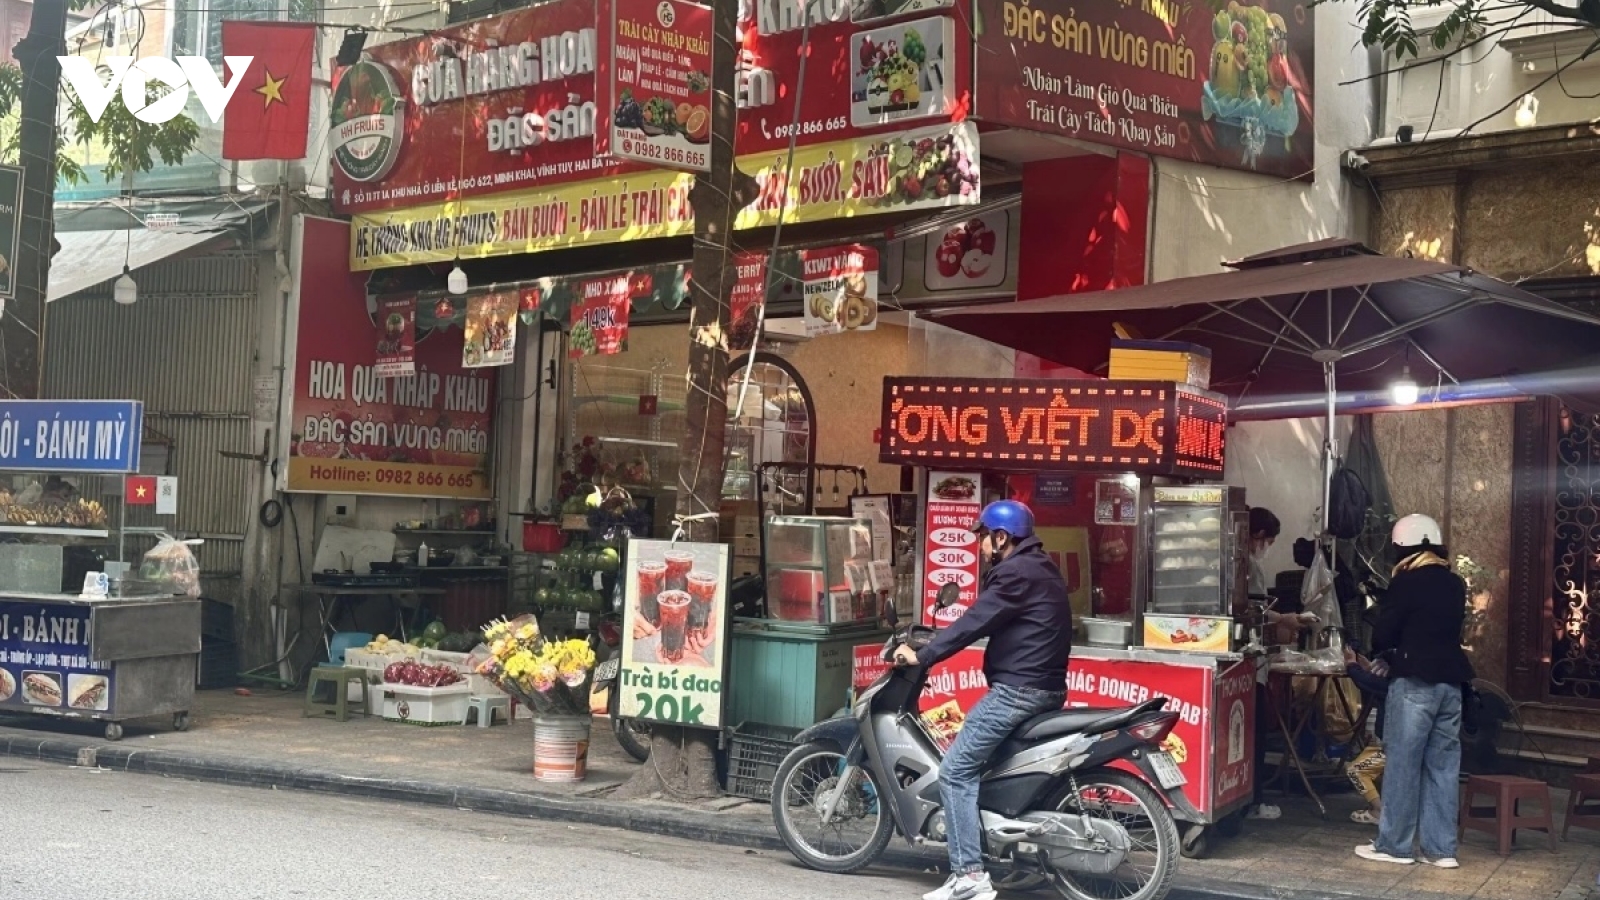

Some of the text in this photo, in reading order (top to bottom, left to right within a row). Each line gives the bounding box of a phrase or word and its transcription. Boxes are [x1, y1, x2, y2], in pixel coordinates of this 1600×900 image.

[618, 18, 710, 56] TRÁI CÂY NHẬP KHẨU
[540, 28, 596, 82] HOA
[1022, 66, 1060, 95] Nhận
[1064, 75, 1094, 100] Làm
[354, 118, 384, 134] FRUITS
[775, 116, 847, 138] 0982 866 665
[1026, 100, 1054, 124] Trái
[1058, 106, 1082, 134] Cây
[1084, 110, 1116, 136] Tách
[1118, 117, 1152, 146] Khay
[635, 142, 705, 166] 0982 866 665
[503, 199, 529, 242] BÁN
[531, 196, 569, 239] BUÔN
[579, 190, 609, 232] BÁN
[611, 182, 627, 230] LẺ
[631, 182, 664, 226] TRÁI
[736, 262, 761, 279] ERRY
[804, 258, 832, 274] KIWI
[308, 360, 346, 400] HOA
[392, 364, 440, 416] NHẬP
[444, 369, 489, 414] KHẨU
[36, 411, 90, 459] BÁNH
[94, 412, 126, 460] MỲ
[304, 412, 345, 447] ĐẶC
[310, 465, 473, 488] Hotline: 0982 866 665
[940, 532, 966, 543] 25K
[938, 552, 966, 564] 30K
[938, 572, 965, 584] 35K
[928, 590, 938, 598] SIZ
[22, 608, 79, 646] BÁNH
[621, 666, 653, 688] Trà
[658, 668, 678, 690] bí
[682, 674, 721, 693] đao
[959, 666, 988, 690] BÁN
[1099, 677, 1148, 704] DONER
[636, 692, 704, 726] 20k
